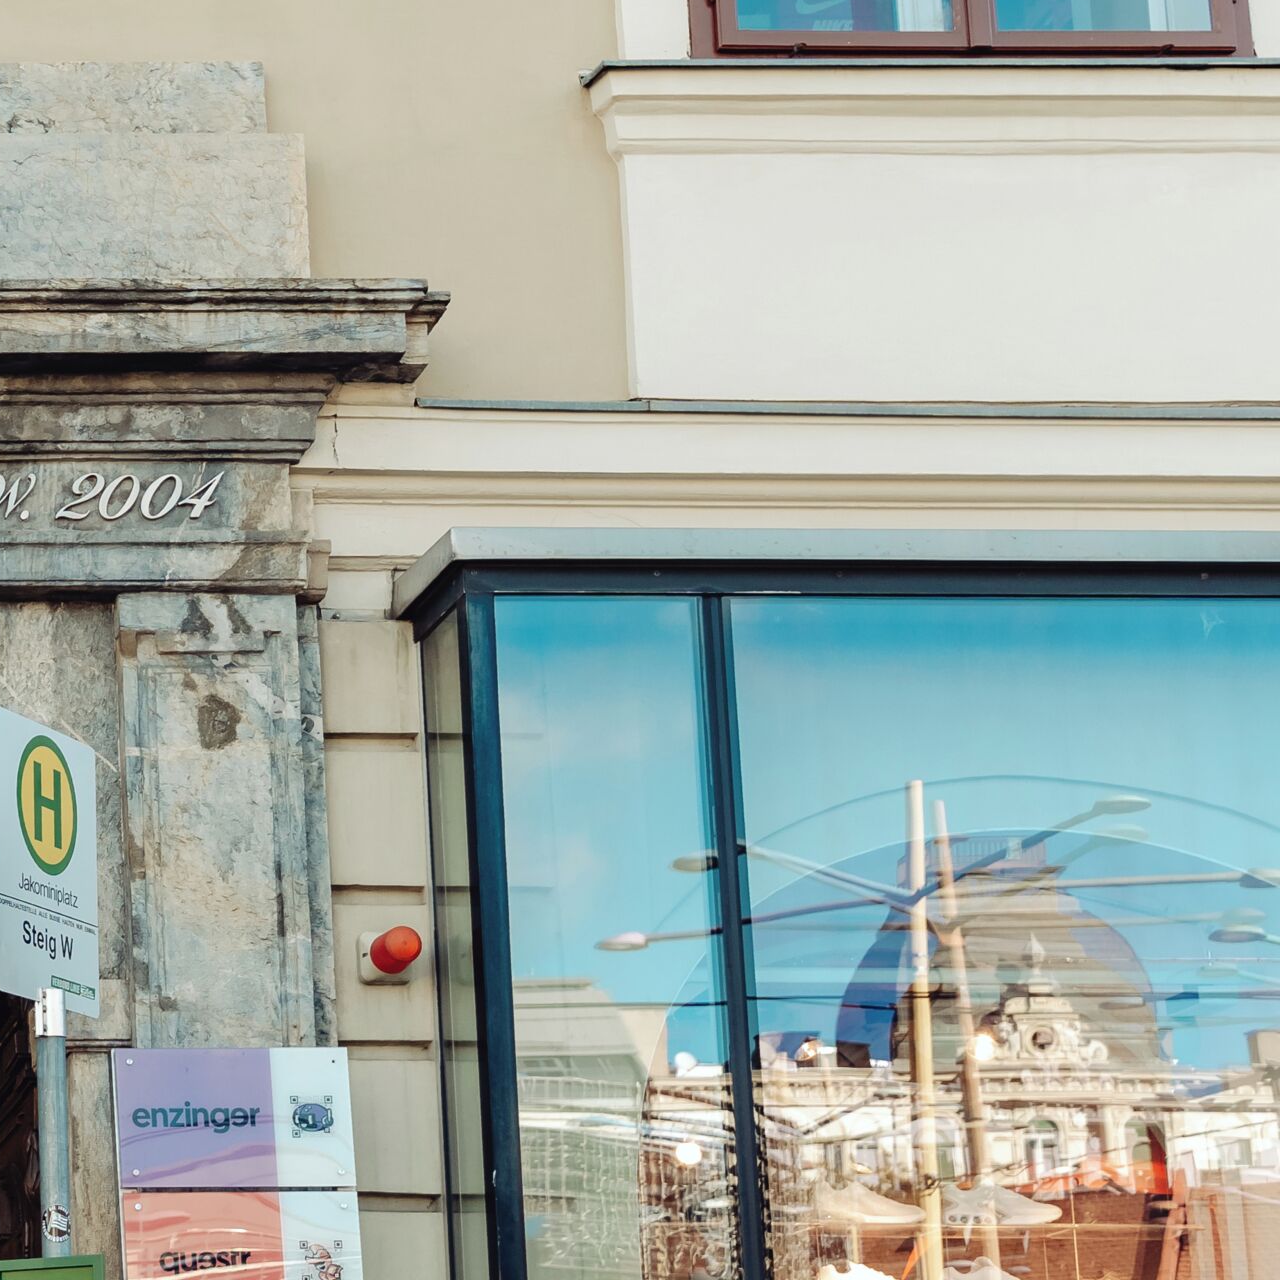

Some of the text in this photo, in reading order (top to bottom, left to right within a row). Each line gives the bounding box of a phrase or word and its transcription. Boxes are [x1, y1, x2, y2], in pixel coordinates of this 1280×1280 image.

[55, 471, 225, 521] 2004
[33, 760, 62, 850] H
[18, 873, 79, 908] Jakominiplatz
[22, 920, 74, 960] Steig W
